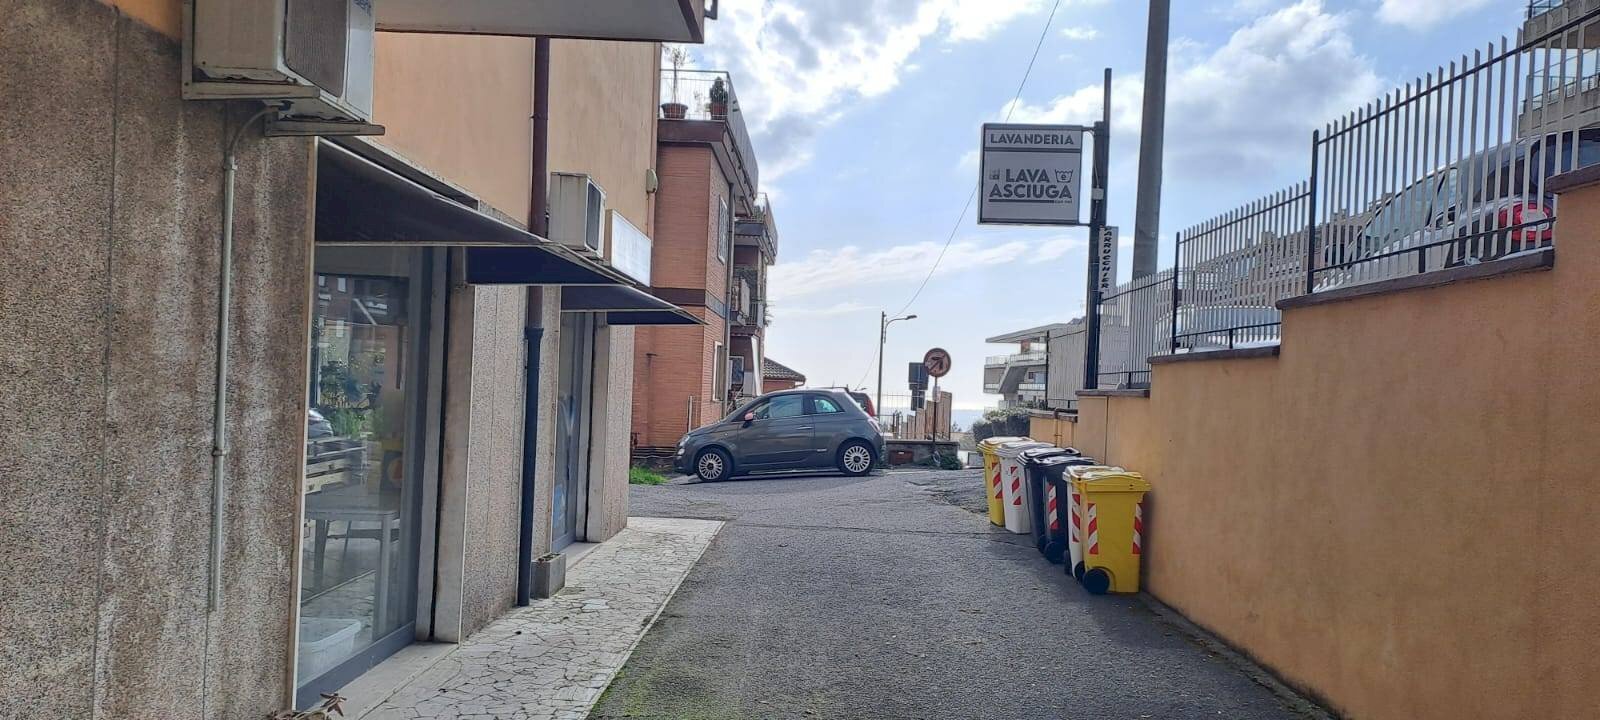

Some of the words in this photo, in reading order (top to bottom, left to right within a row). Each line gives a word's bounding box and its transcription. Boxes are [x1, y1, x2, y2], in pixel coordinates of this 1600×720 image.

[990, 133, 1074, 145] LAVANDERIA
[1006, 169, 1050, 183] LAVA
[989, 184, 1072, 199] ASCIUGA
